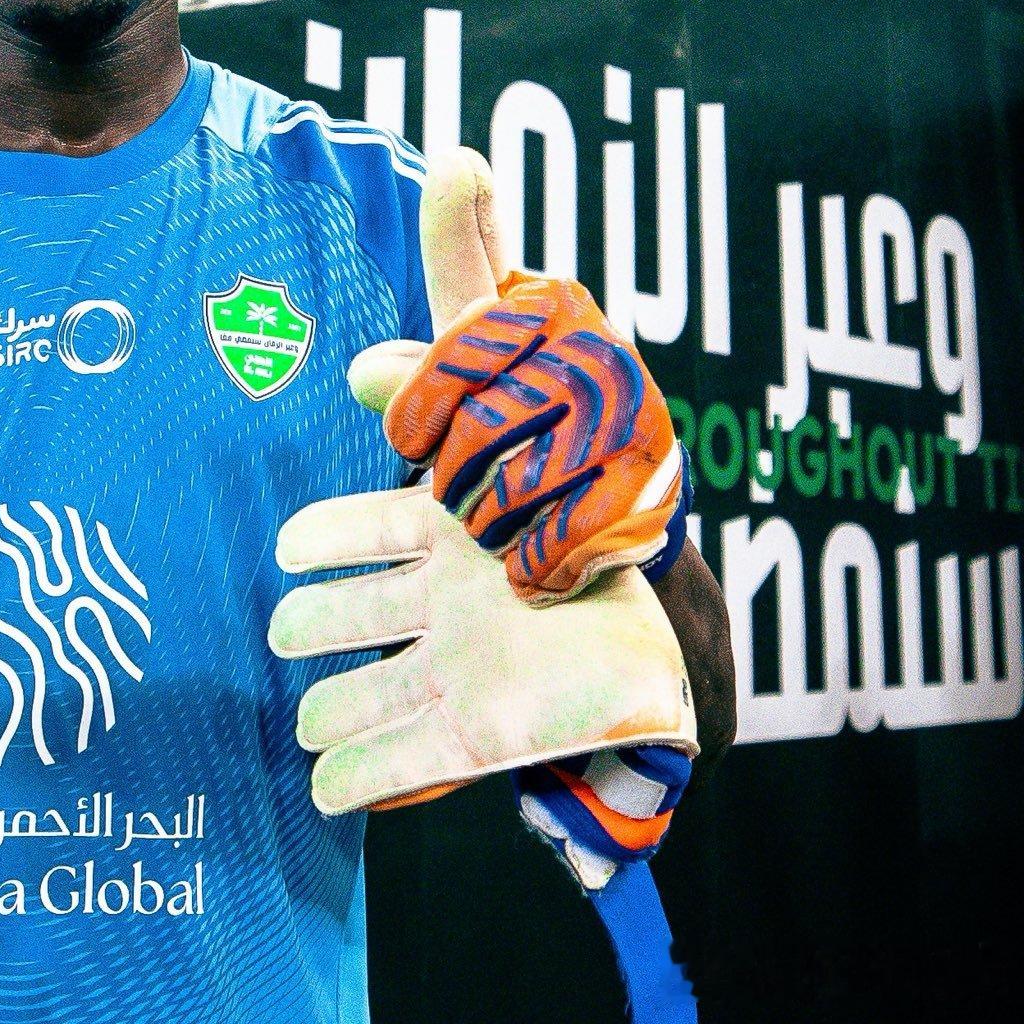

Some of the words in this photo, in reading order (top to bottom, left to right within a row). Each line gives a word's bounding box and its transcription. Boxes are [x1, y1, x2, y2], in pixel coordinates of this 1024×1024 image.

[766, 181, 982, 455] وعبر
[687, 449, 1023, 746] سنمض
[39, 860, 205, 917] Global
[112, 793, 205, 851] البحر
